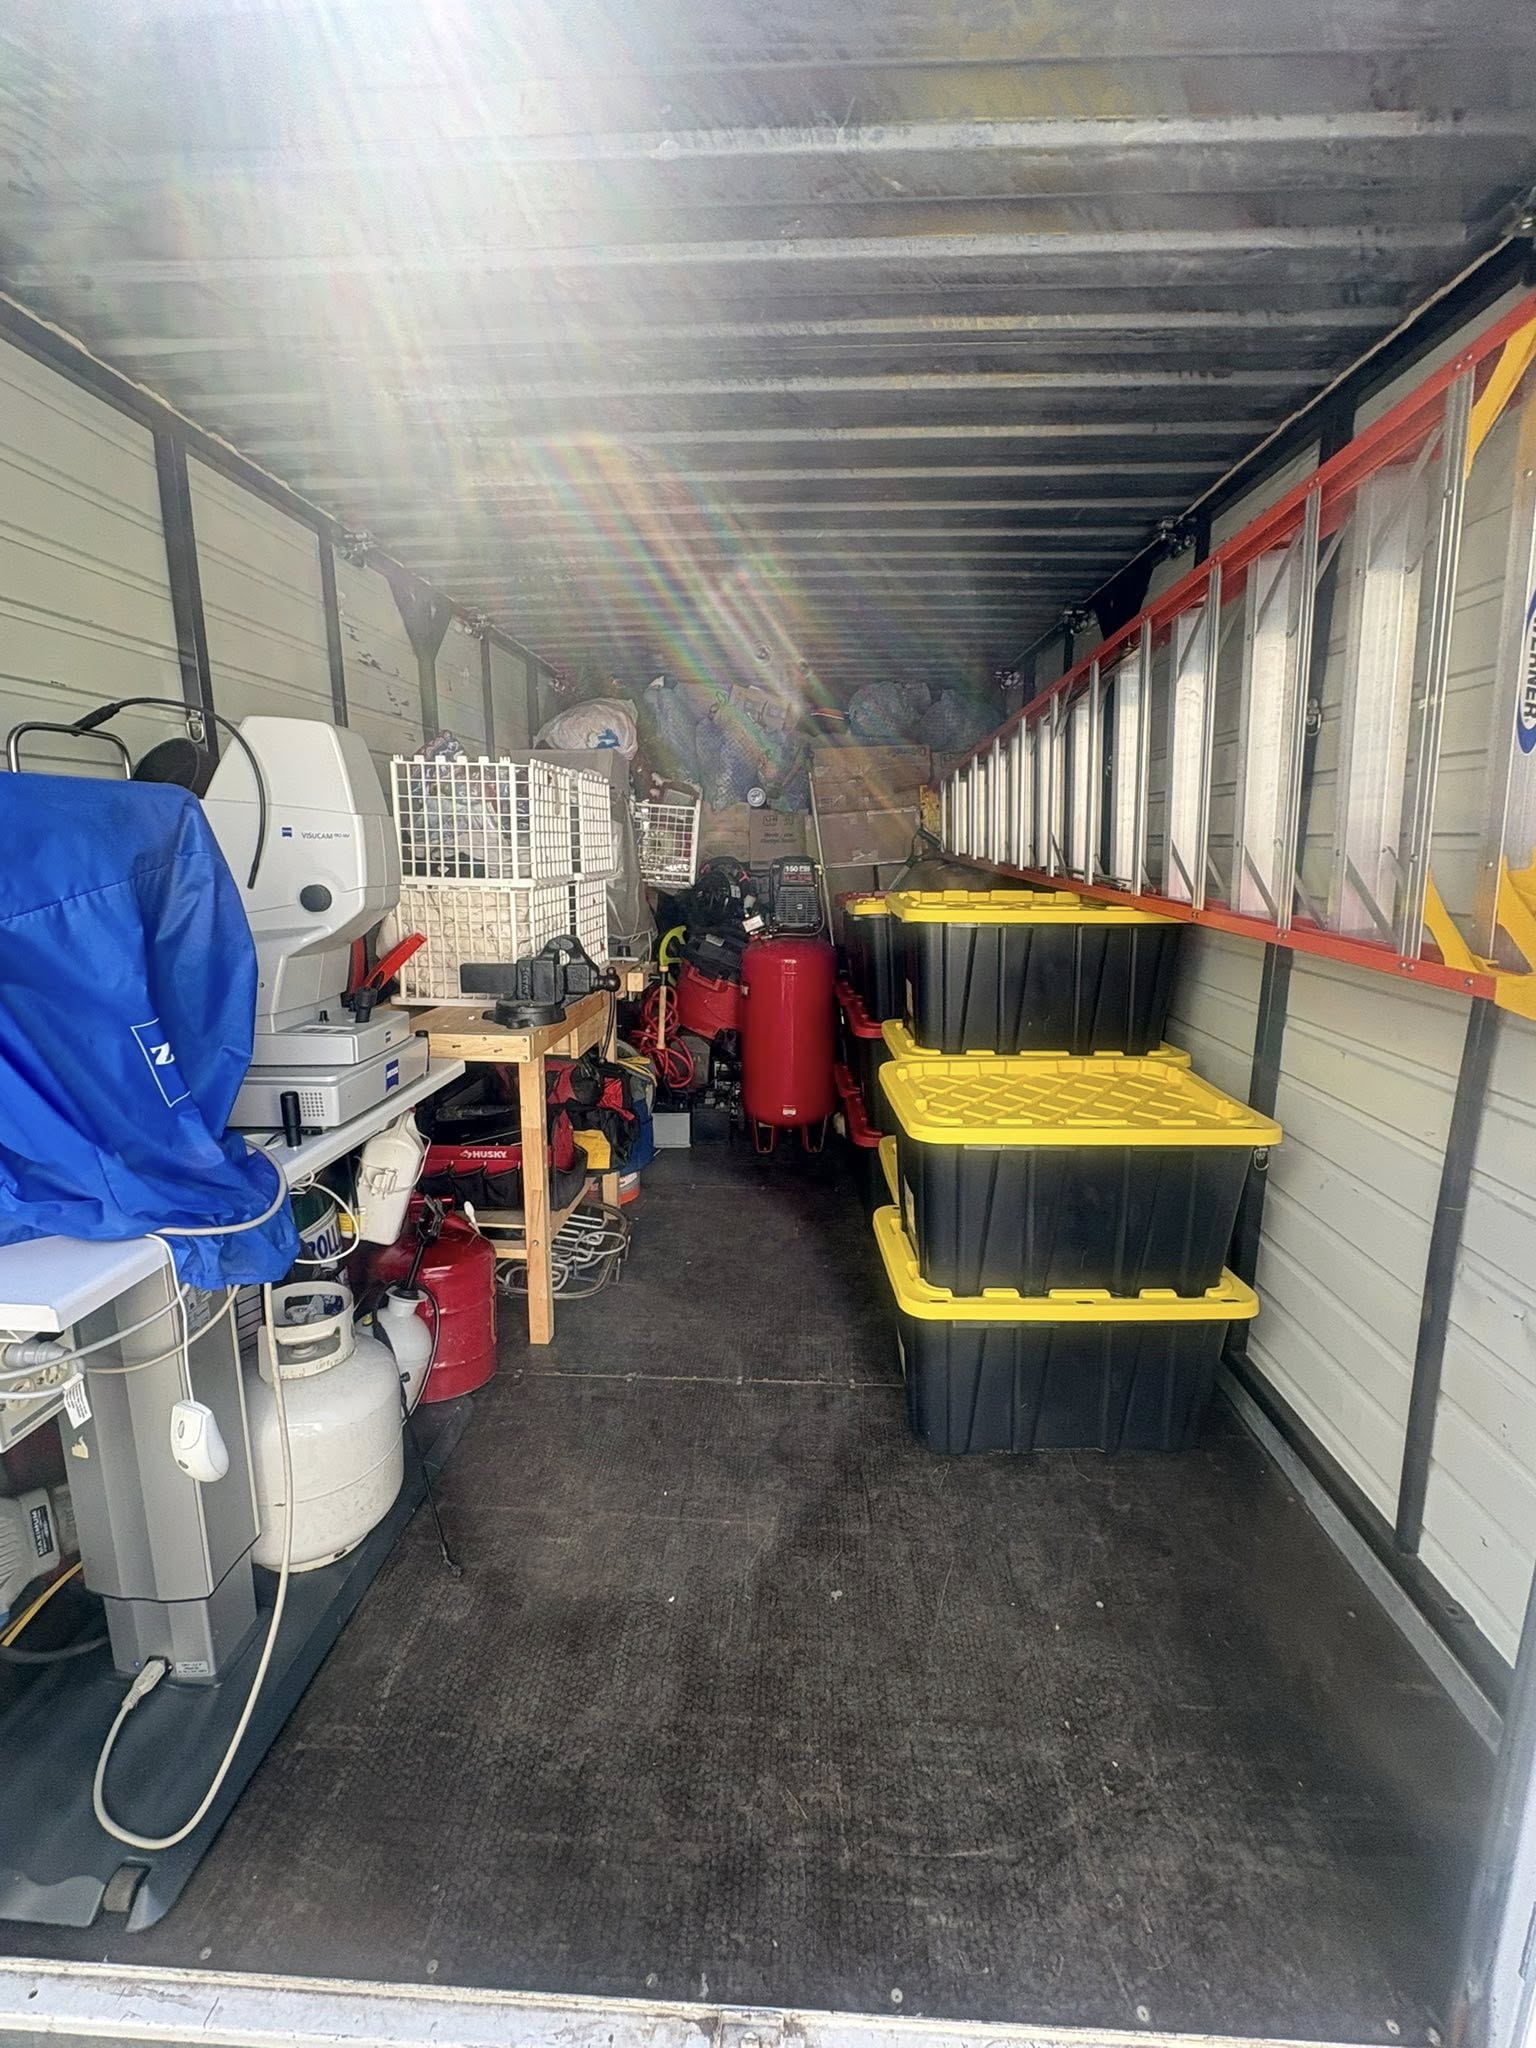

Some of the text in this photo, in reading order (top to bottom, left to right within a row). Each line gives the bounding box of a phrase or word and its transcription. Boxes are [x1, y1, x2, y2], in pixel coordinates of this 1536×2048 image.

[301, 831, 333, 840] VISUCAM
[472, 1150, 508, 1158] HUSKY
[31, 1510, 44, 1556] MAXIMUM
